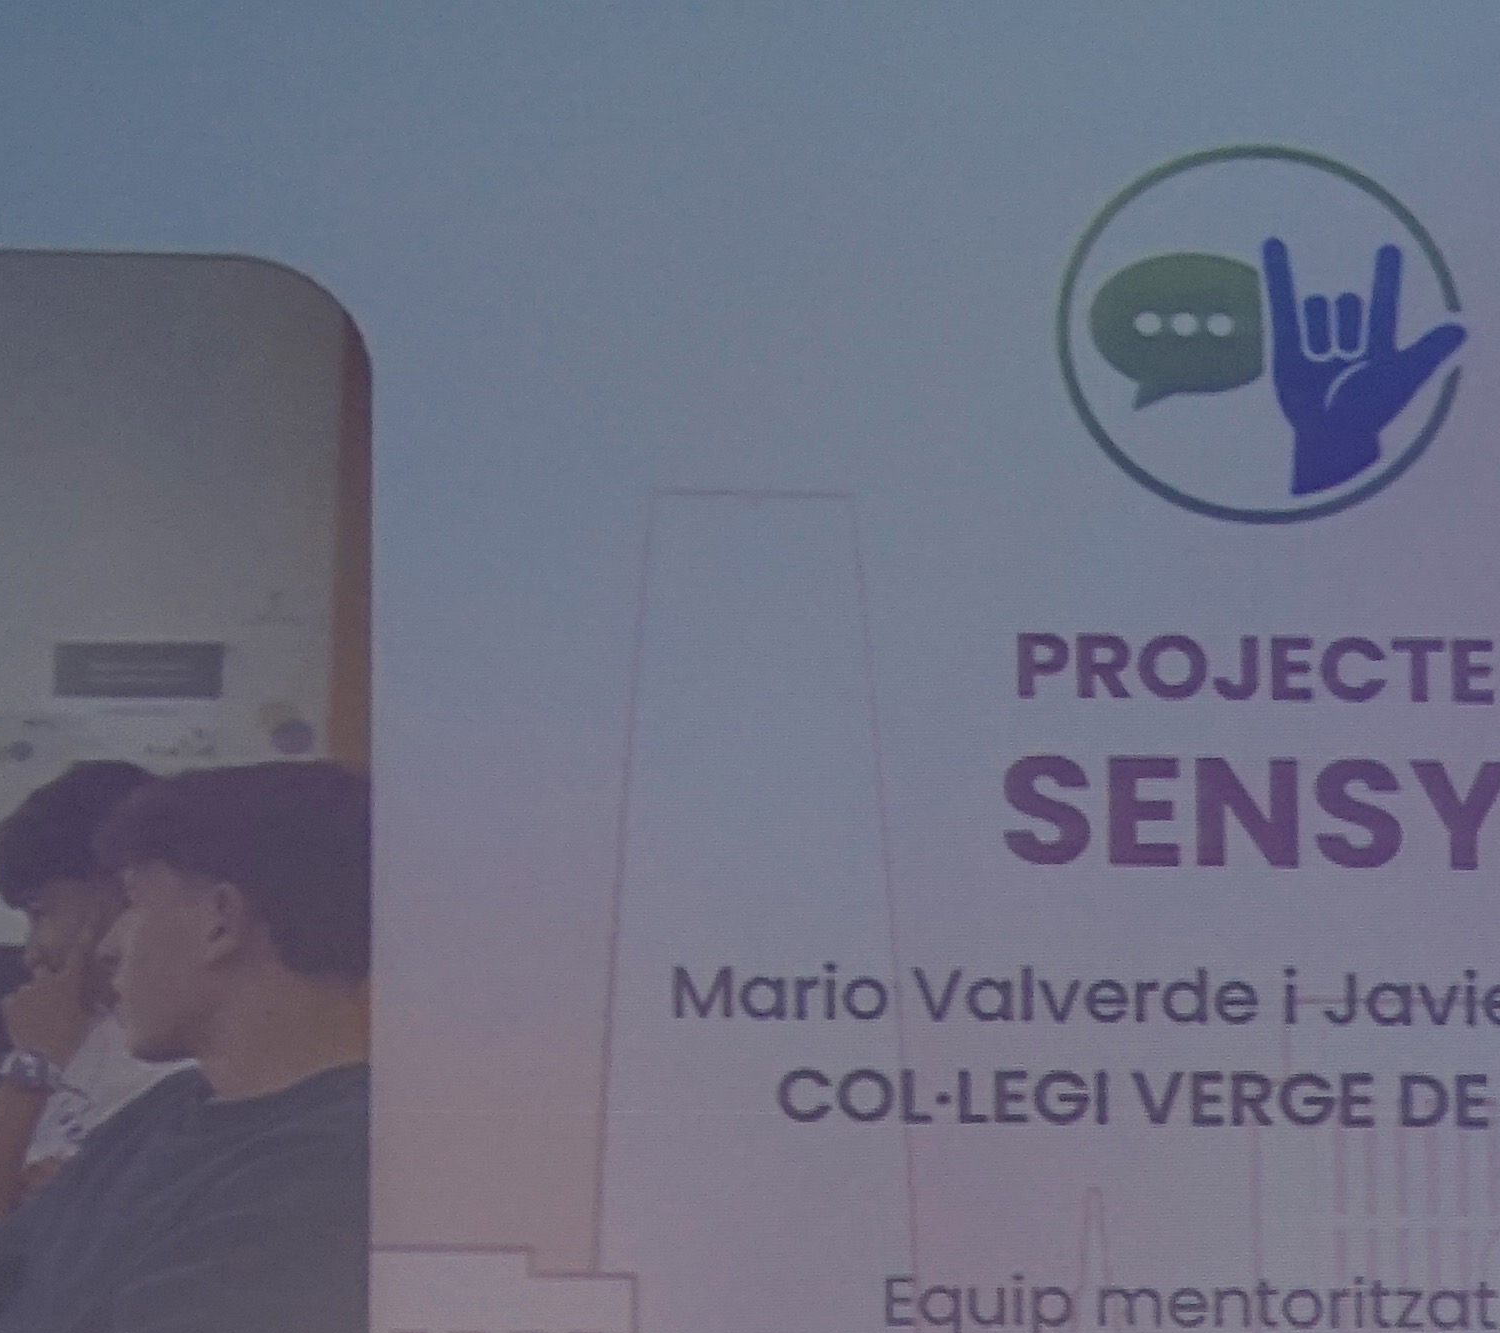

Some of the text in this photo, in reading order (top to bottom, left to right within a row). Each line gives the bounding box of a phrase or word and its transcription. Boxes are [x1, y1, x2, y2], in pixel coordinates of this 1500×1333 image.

[1015, 632, 1496, 706] PROJECTE
[671, 962, 889, 1023] Mario
[911, 966, 1260, 1026] Valverde
[1282, 969, 1301, 1026] i
[777, 1068, 1110, 1127] COL·LEGI
[1131, 1071, 1376, 1129] VERGE
[1399, 1075, 1489, 1130] DE
[1097, 1275, 1500, 1332] mentoritzat
